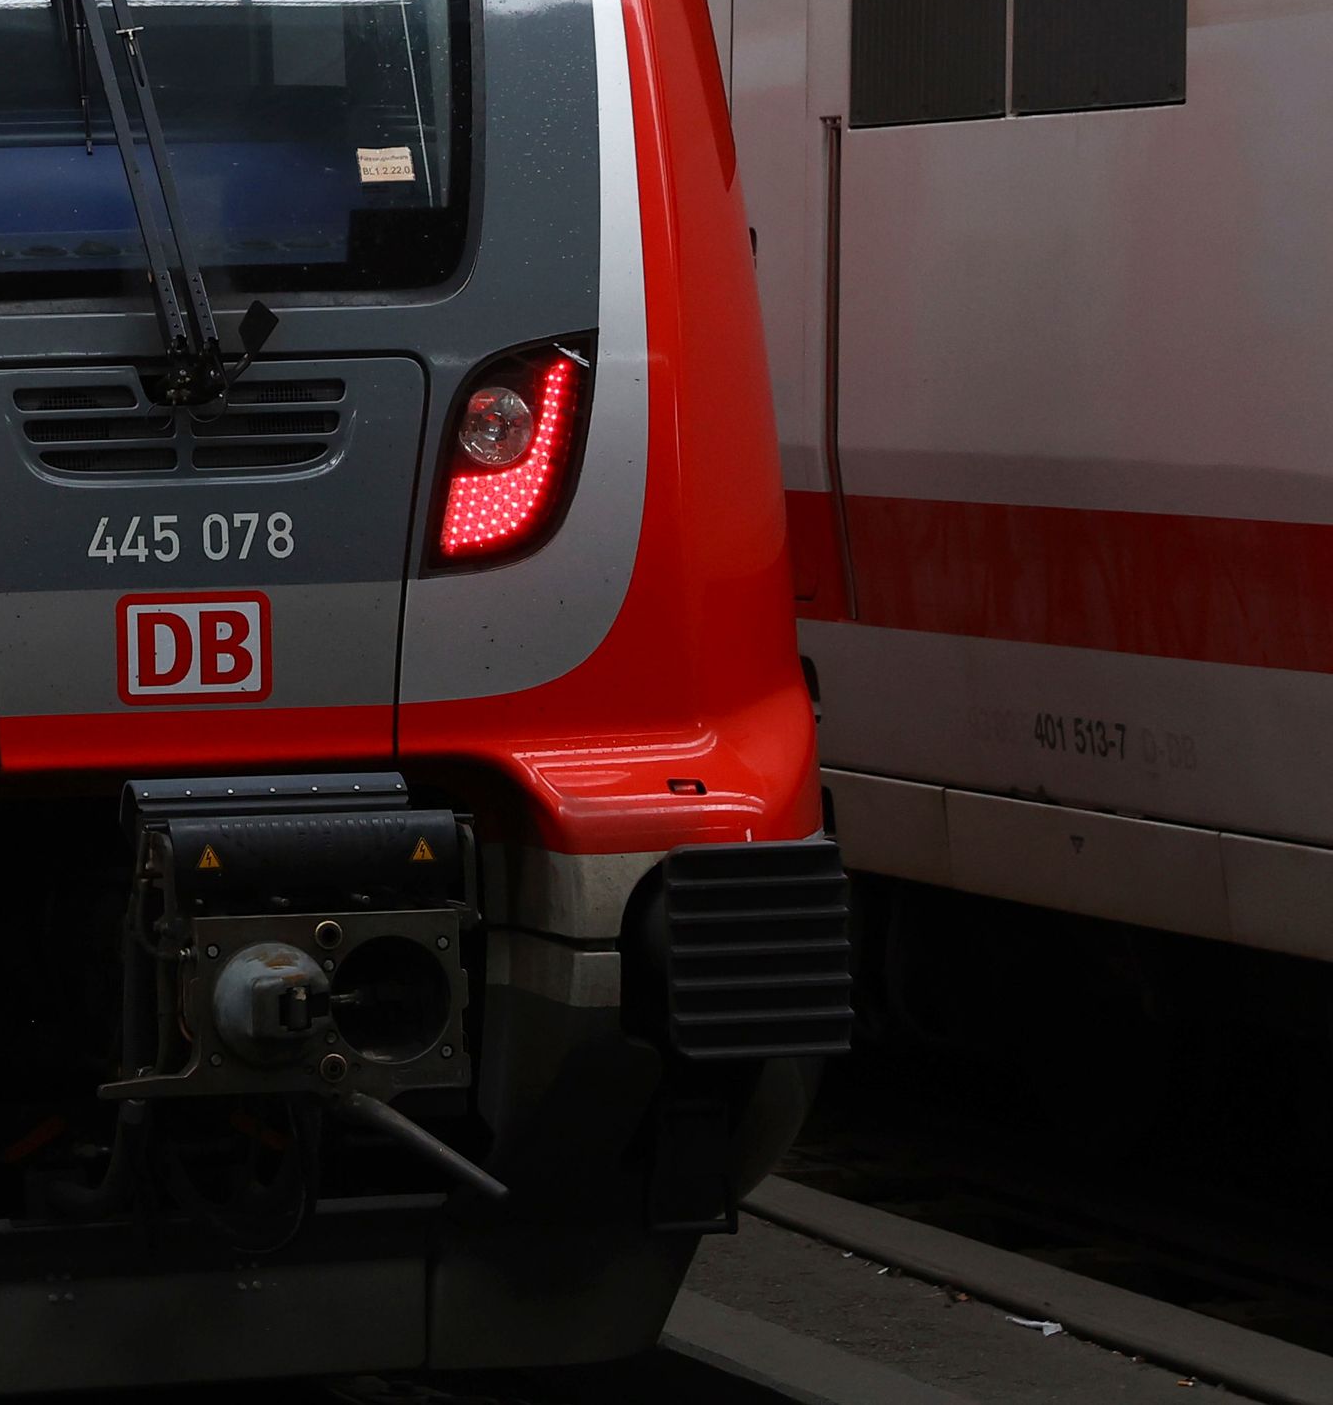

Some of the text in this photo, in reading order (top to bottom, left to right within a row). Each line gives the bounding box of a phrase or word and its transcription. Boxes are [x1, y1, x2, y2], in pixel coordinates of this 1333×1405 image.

[88, 510, 295, 564] 445 078
[136, 609, 254, 688] DB
[1034, 711, 1067, 751] 401
[1073, 717, 1127, 761] 513-7
